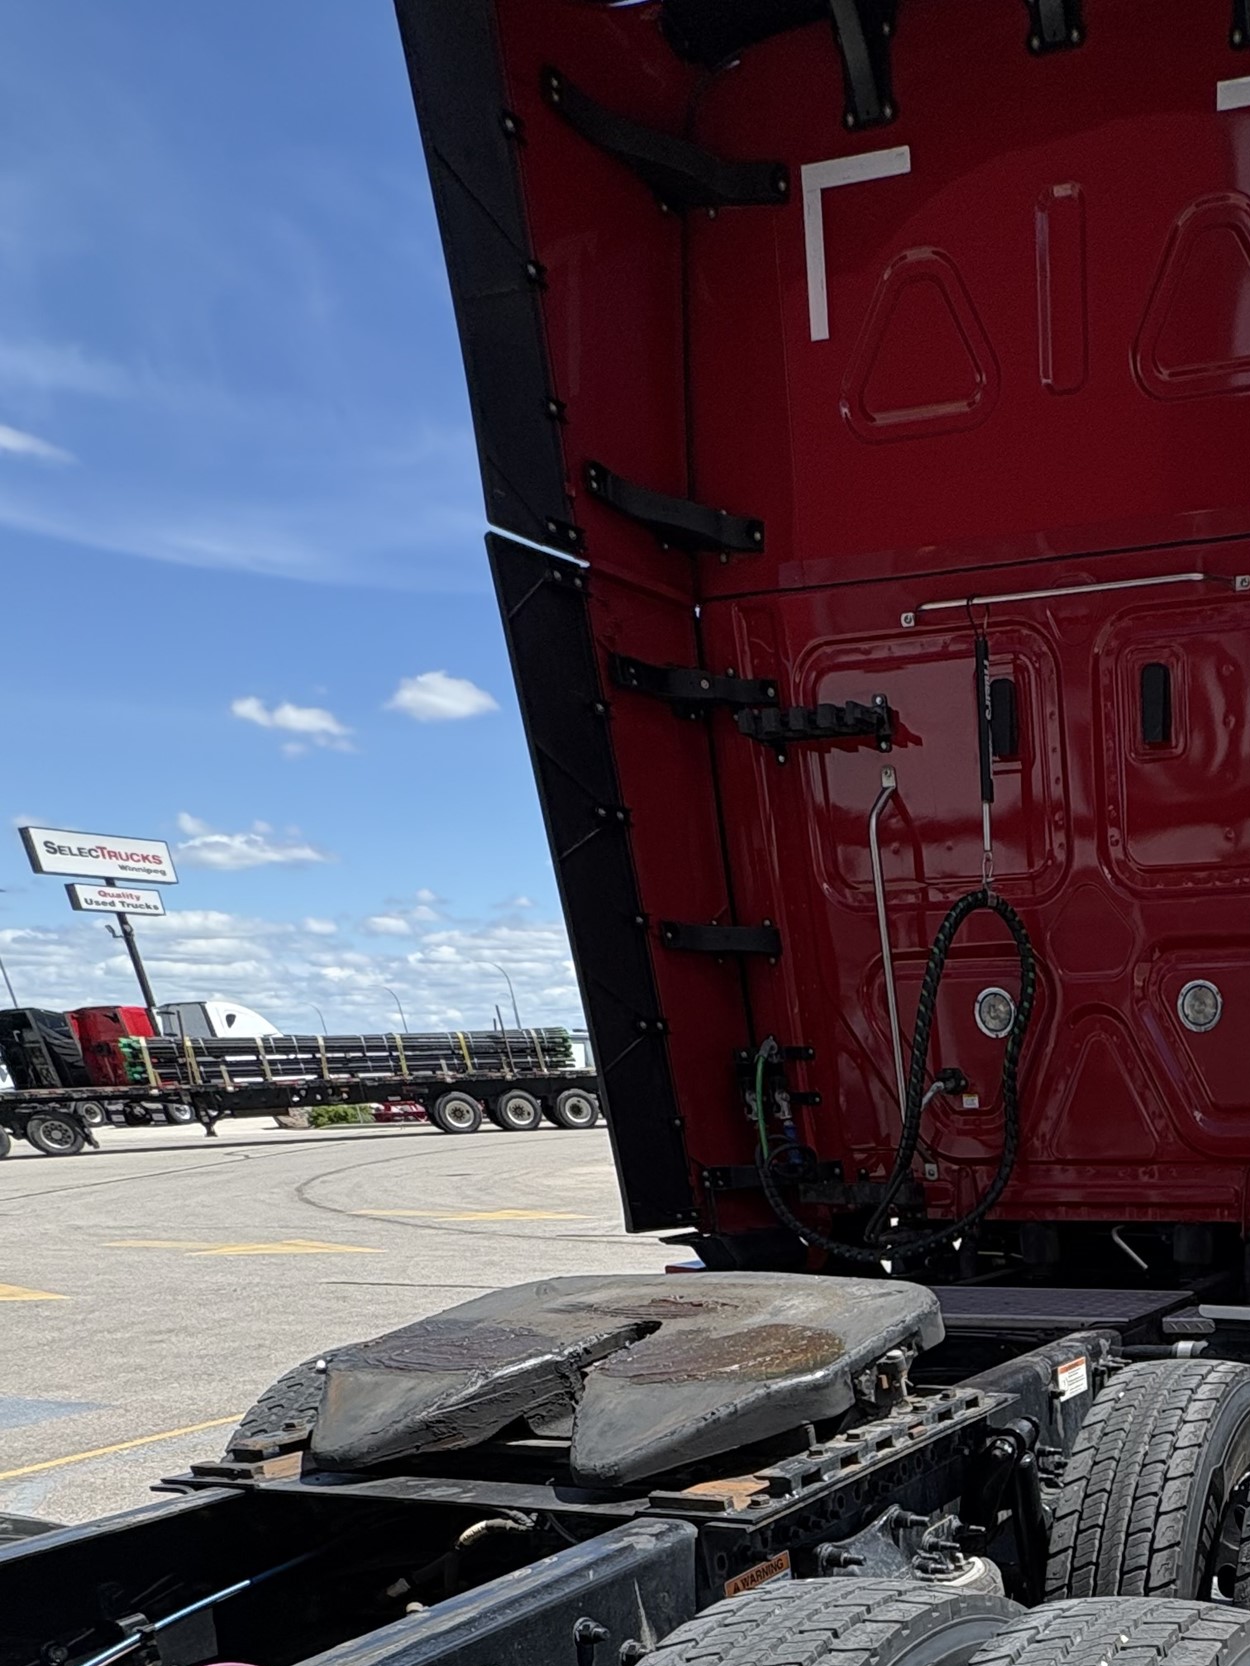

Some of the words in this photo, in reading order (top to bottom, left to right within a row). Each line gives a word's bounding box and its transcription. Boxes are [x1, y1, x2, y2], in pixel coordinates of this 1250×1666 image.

[118, 864, 167, 876] Winnipeg
[98, 890, 141, 901] Quality
[84, 898, 116, 908] Used
[119, 900, 160, 911] Trucks
[741, 1558, 784, 1590] WARNING
